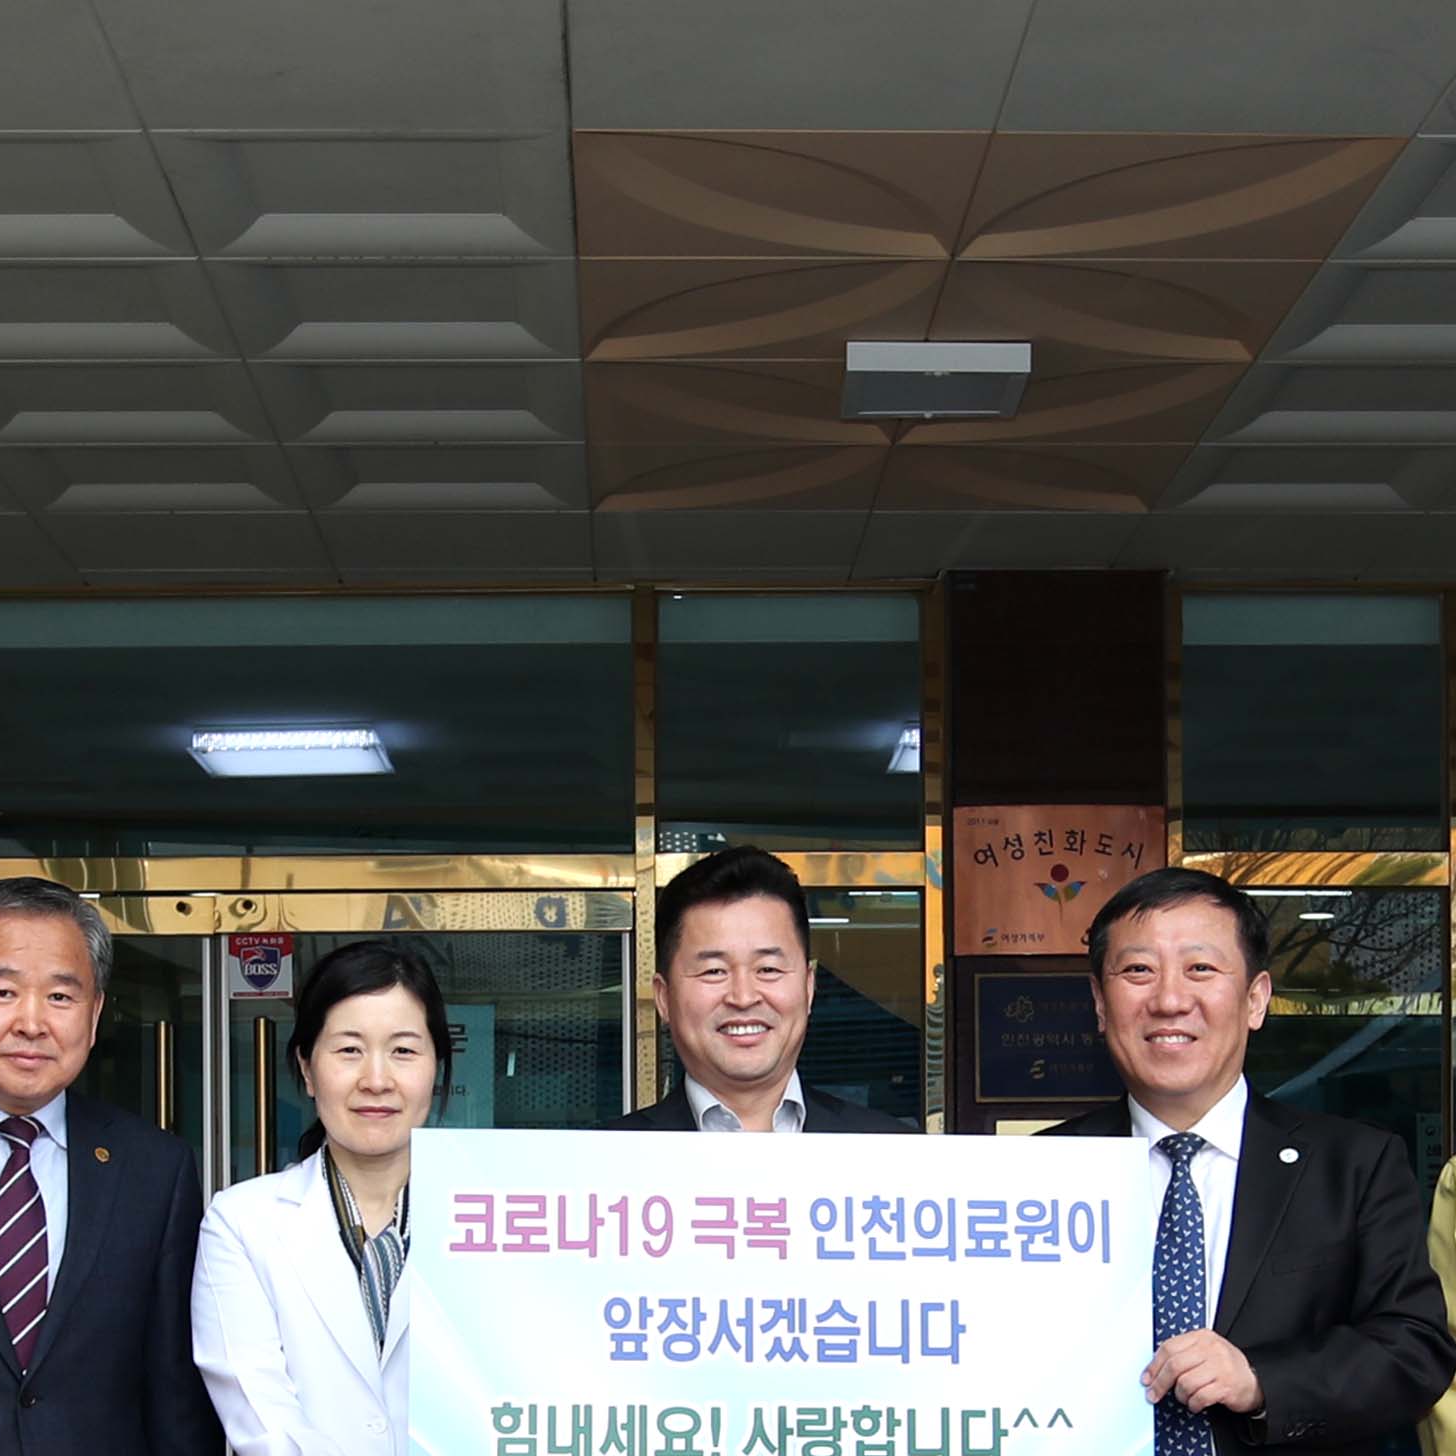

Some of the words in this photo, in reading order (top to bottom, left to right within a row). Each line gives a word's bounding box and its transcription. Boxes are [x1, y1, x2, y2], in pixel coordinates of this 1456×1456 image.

[973, 828, 1144, 870] 여성친화도시
[235, 936, 260, 945] CCTV
[450, 1194, 675, 1258] 코로나19
[691, 1197, 792, 1260] 극복
[810, 1196, 1112, 1263] 인천의료원이
[603, 1297, 967, 1365] 앞장서겠습니다
